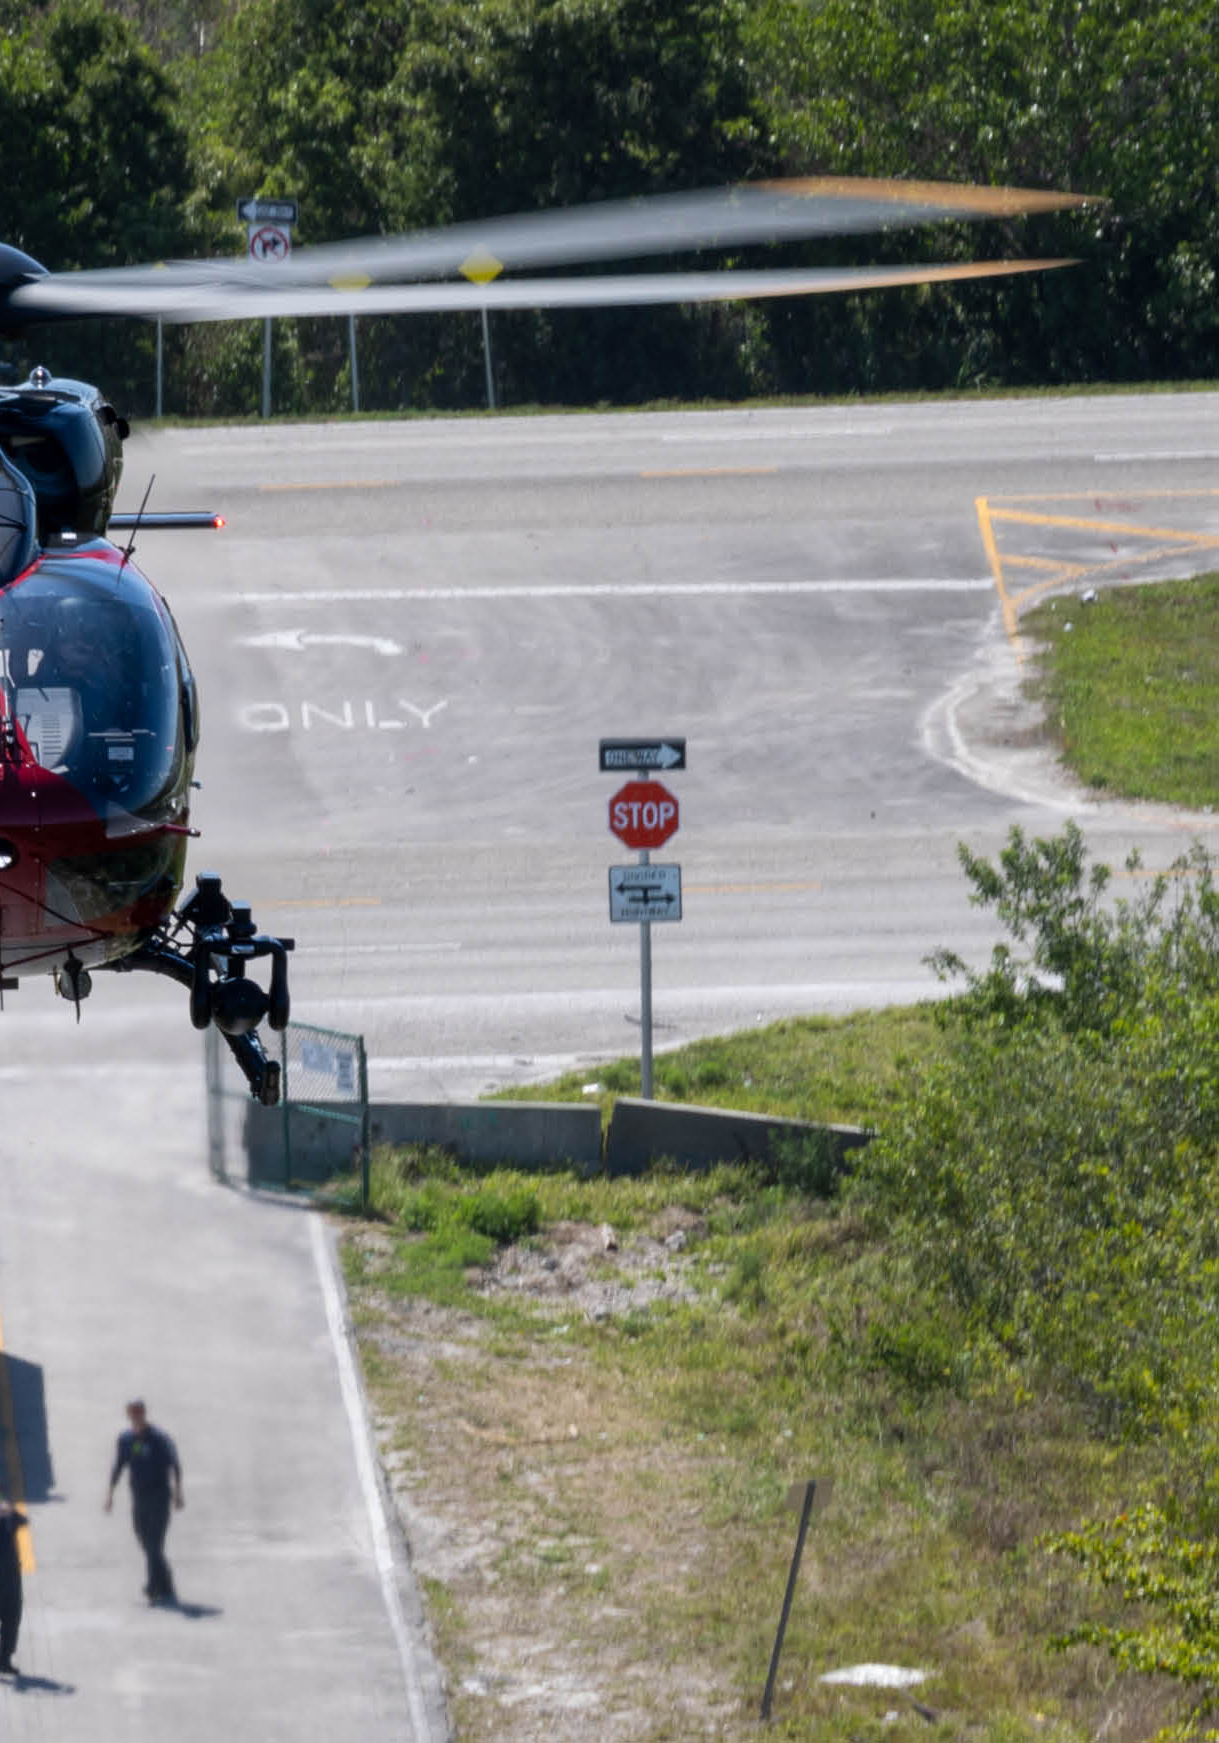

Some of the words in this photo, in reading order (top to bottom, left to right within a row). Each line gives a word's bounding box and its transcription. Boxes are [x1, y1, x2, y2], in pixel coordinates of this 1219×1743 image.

[239, 700, 449, 731] ONLY
[605, 750, 630, 766] ONE
[636, 749, 660, 764] WAY
[613, 802, 675, 829] STOP
